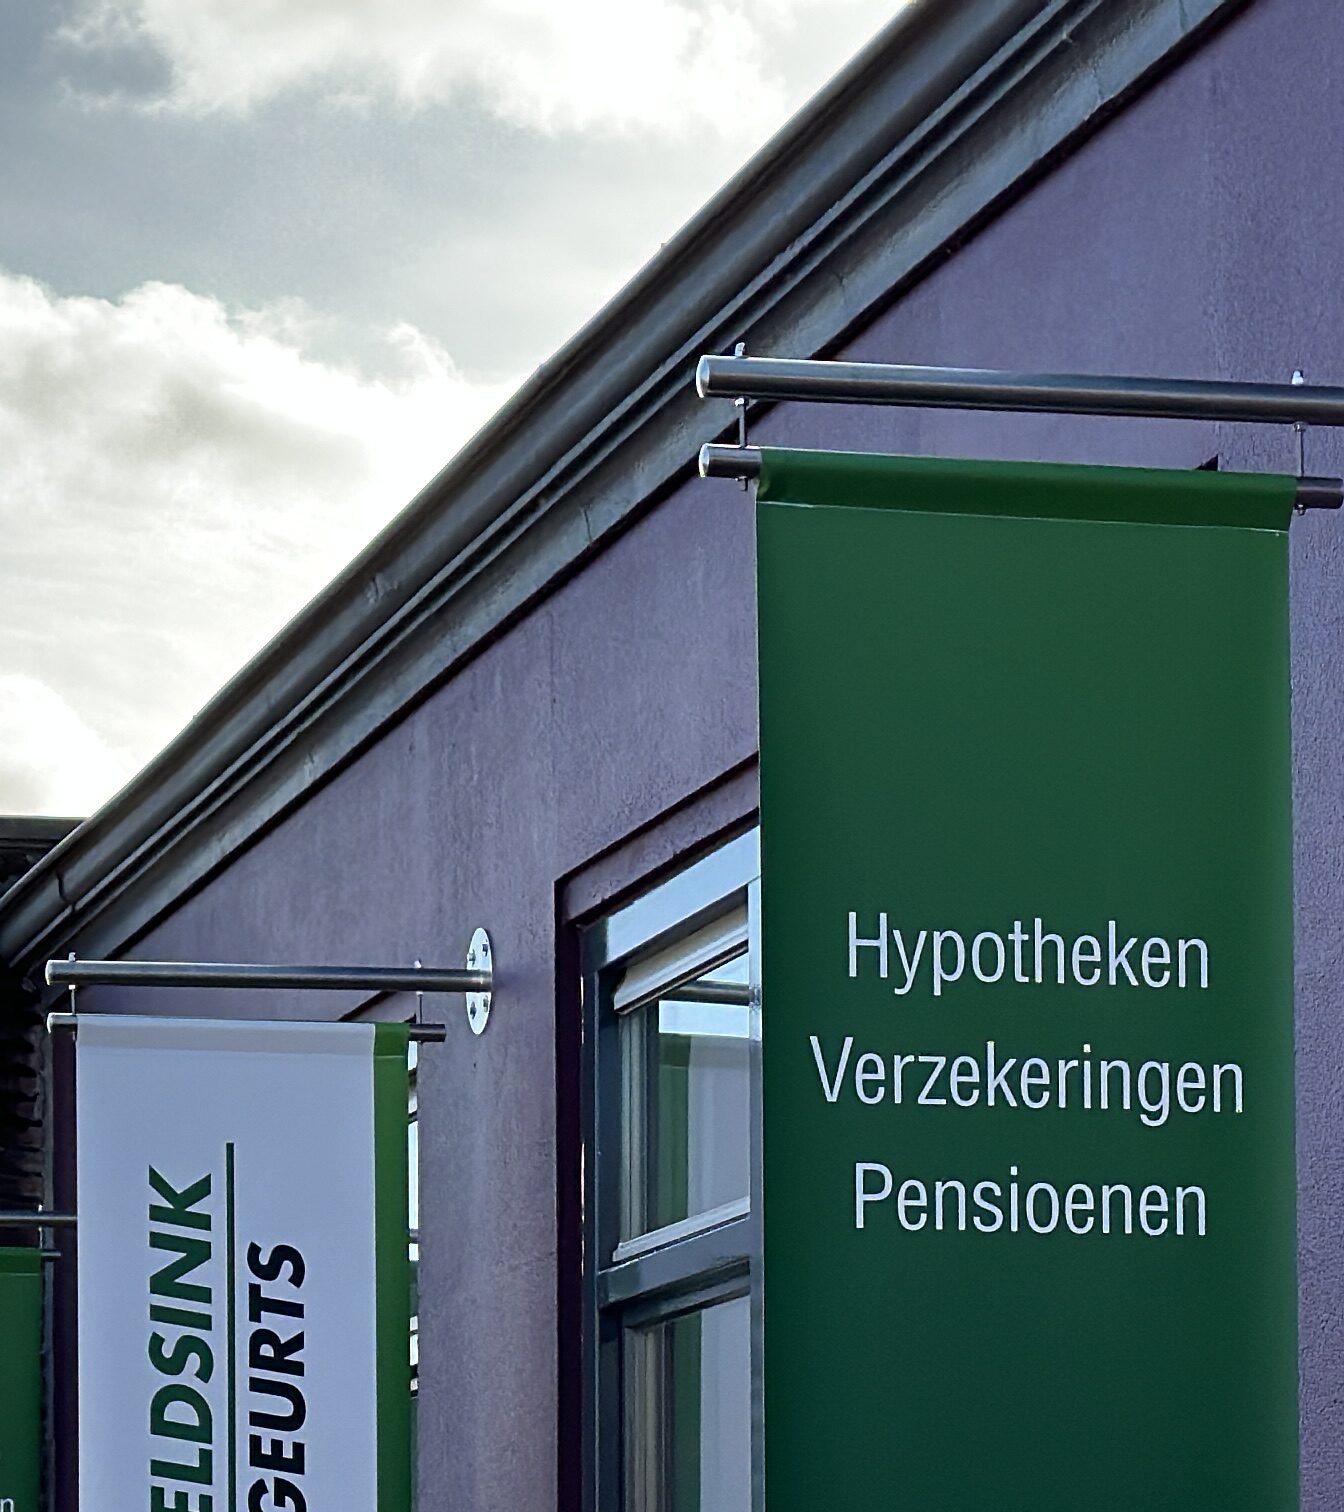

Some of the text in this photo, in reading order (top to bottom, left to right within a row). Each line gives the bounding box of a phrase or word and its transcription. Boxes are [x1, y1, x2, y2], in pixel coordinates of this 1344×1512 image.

[847, 911, 1210, 997] Hypotheken
[809, 1035, 1245, 1127] Verzekeringen
[854, 1162, 1207, 1237] Pensioenen
